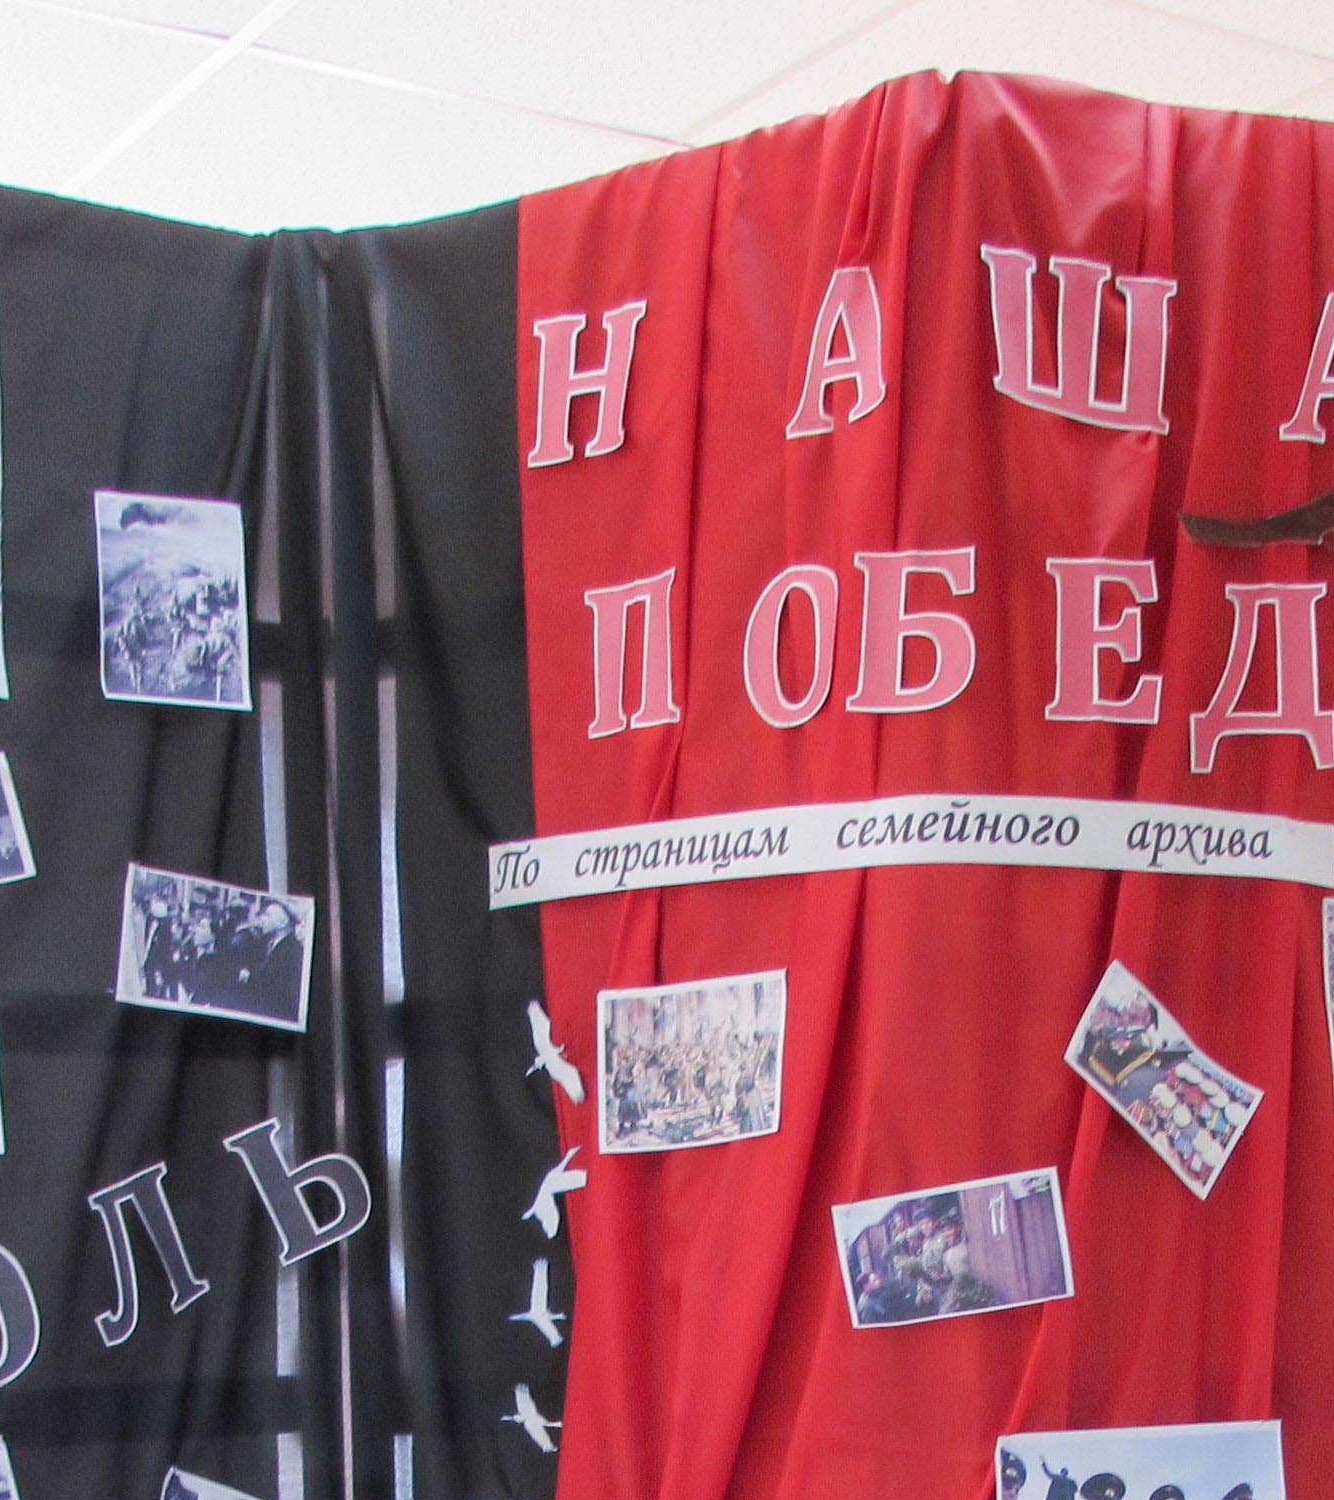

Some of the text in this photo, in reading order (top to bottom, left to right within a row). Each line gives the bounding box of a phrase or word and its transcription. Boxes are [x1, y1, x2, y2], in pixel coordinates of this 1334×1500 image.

[491, 800, 1274, 895] По страницам семейного архива
